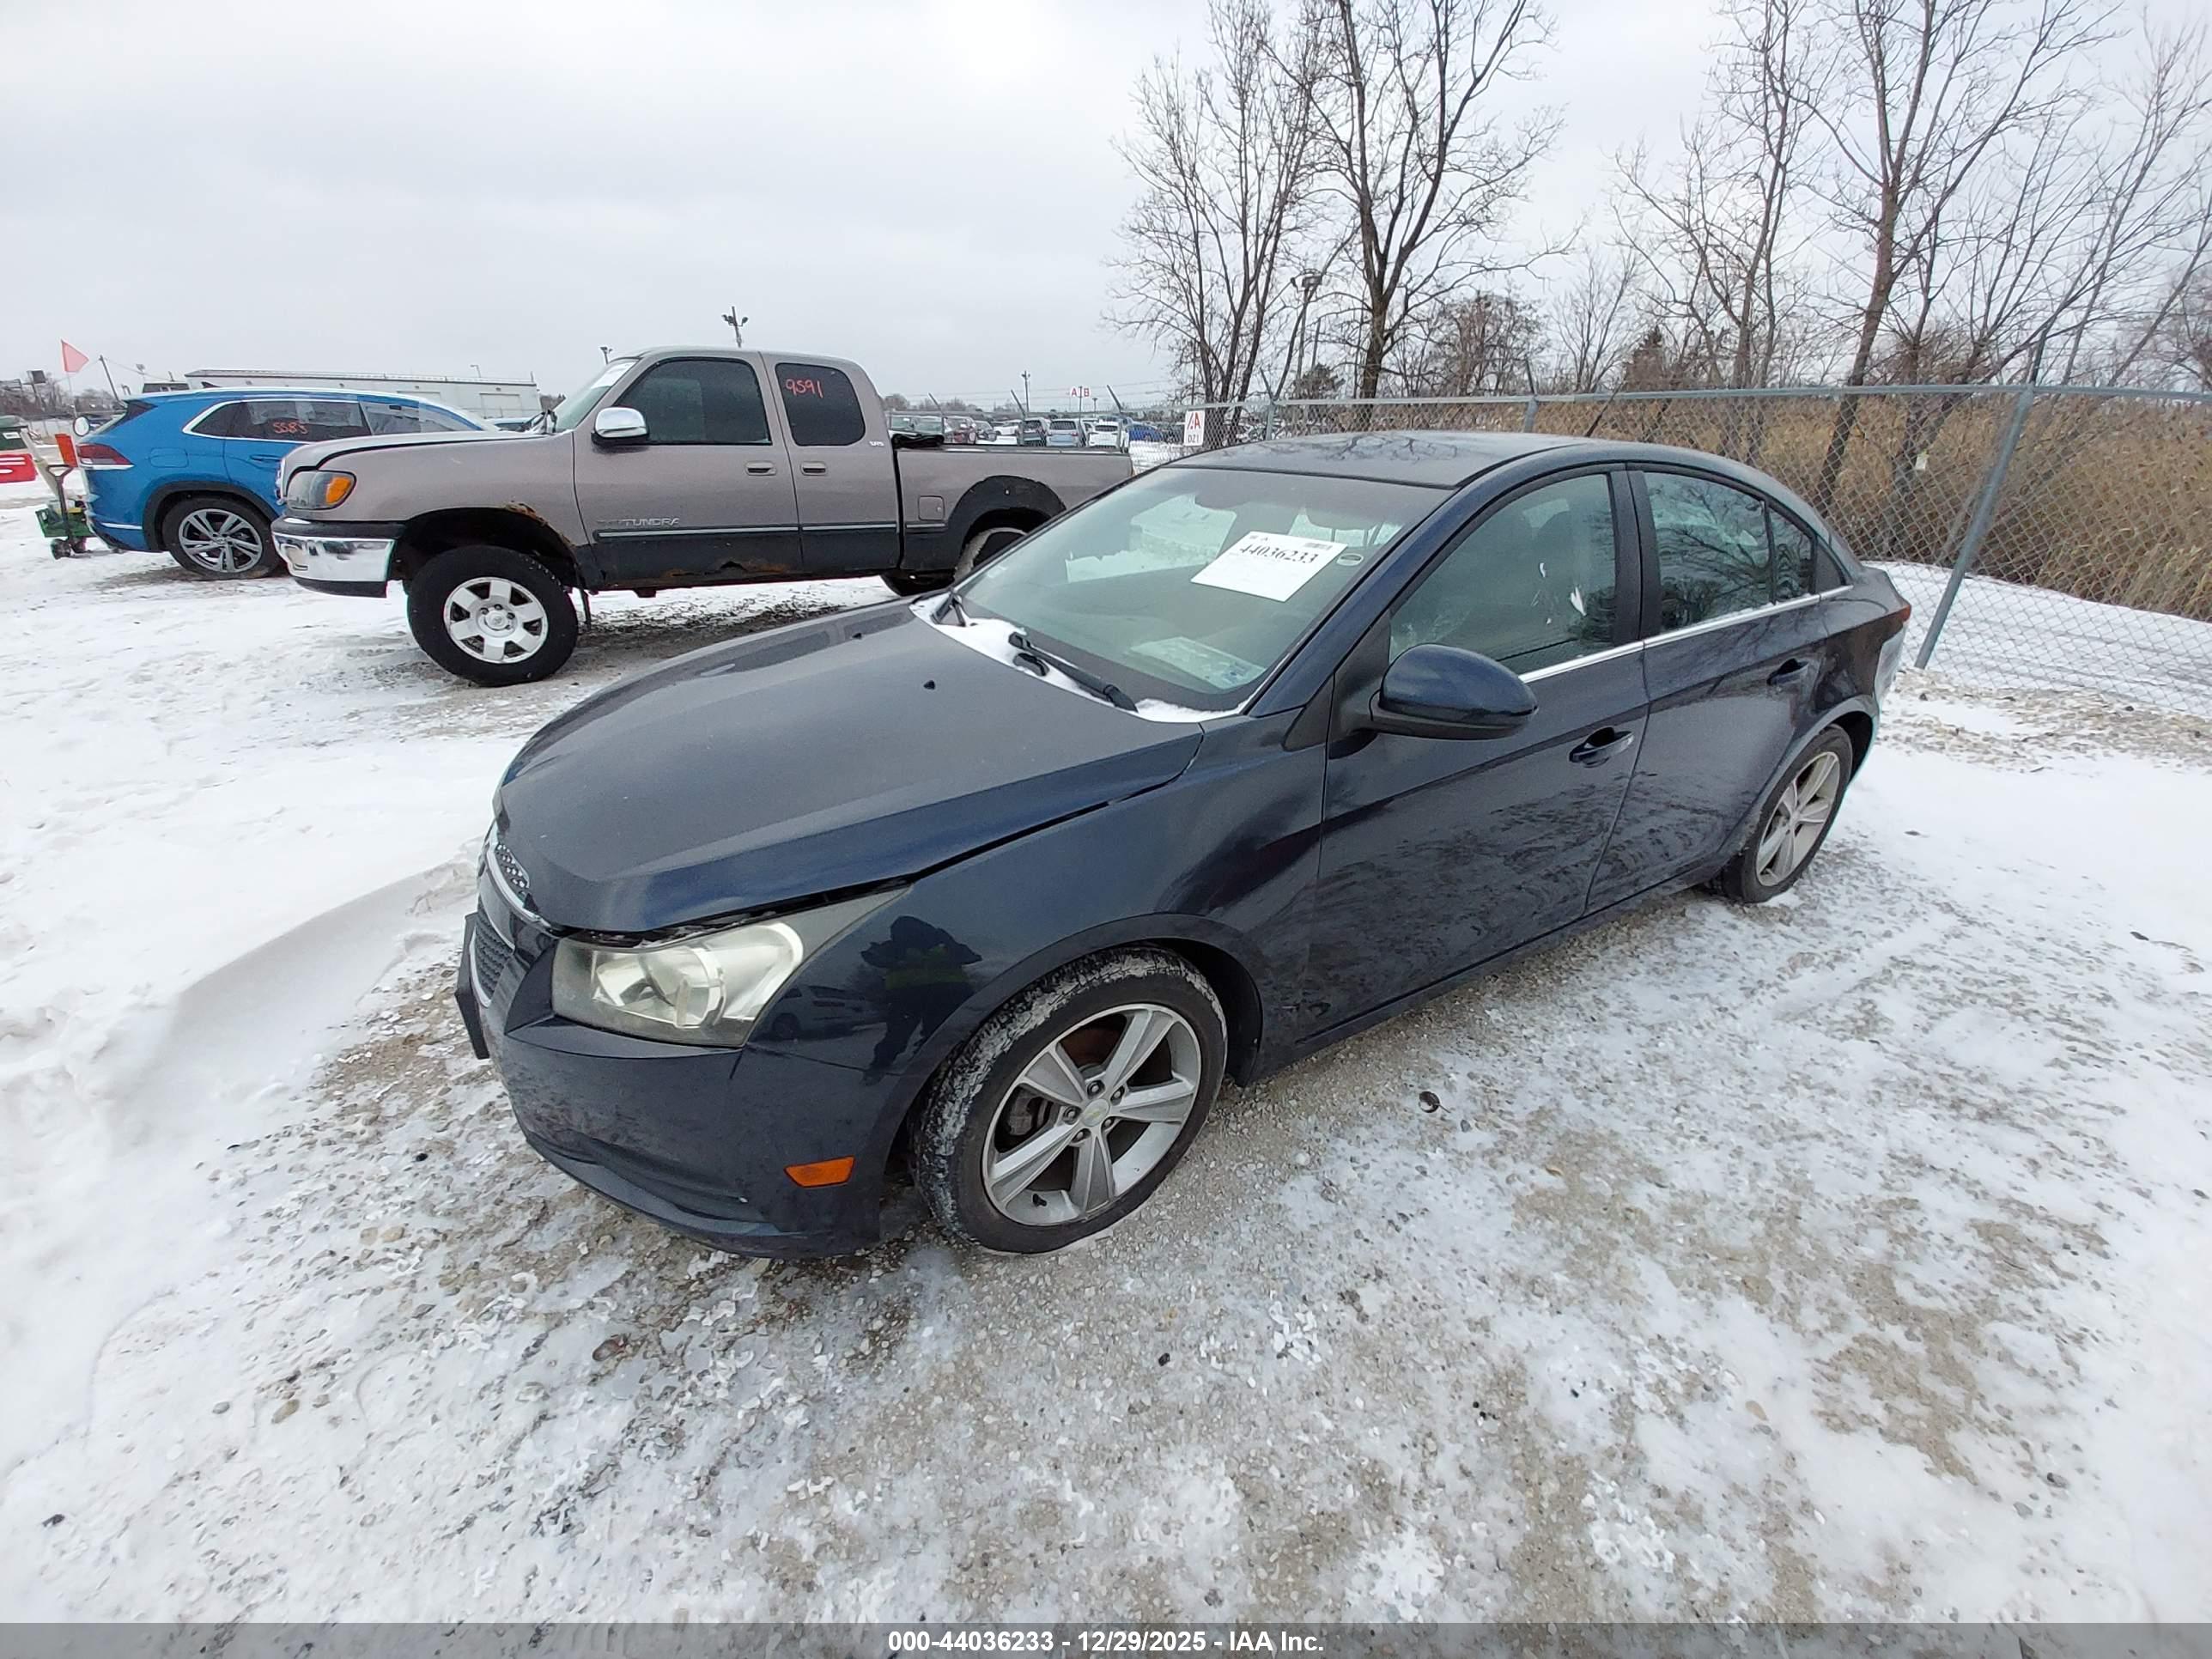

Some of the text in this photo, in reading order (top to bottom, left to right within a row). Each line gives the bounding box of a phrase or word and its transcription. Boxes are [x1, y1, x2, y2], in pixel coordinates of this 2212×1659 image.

[786, 379, 823, 399] 9591
[1071, 387, 1090, 397] A B
[621, 517, 680, 526] TUNDRA
[1239, 543, 1320, 563] 44036233
